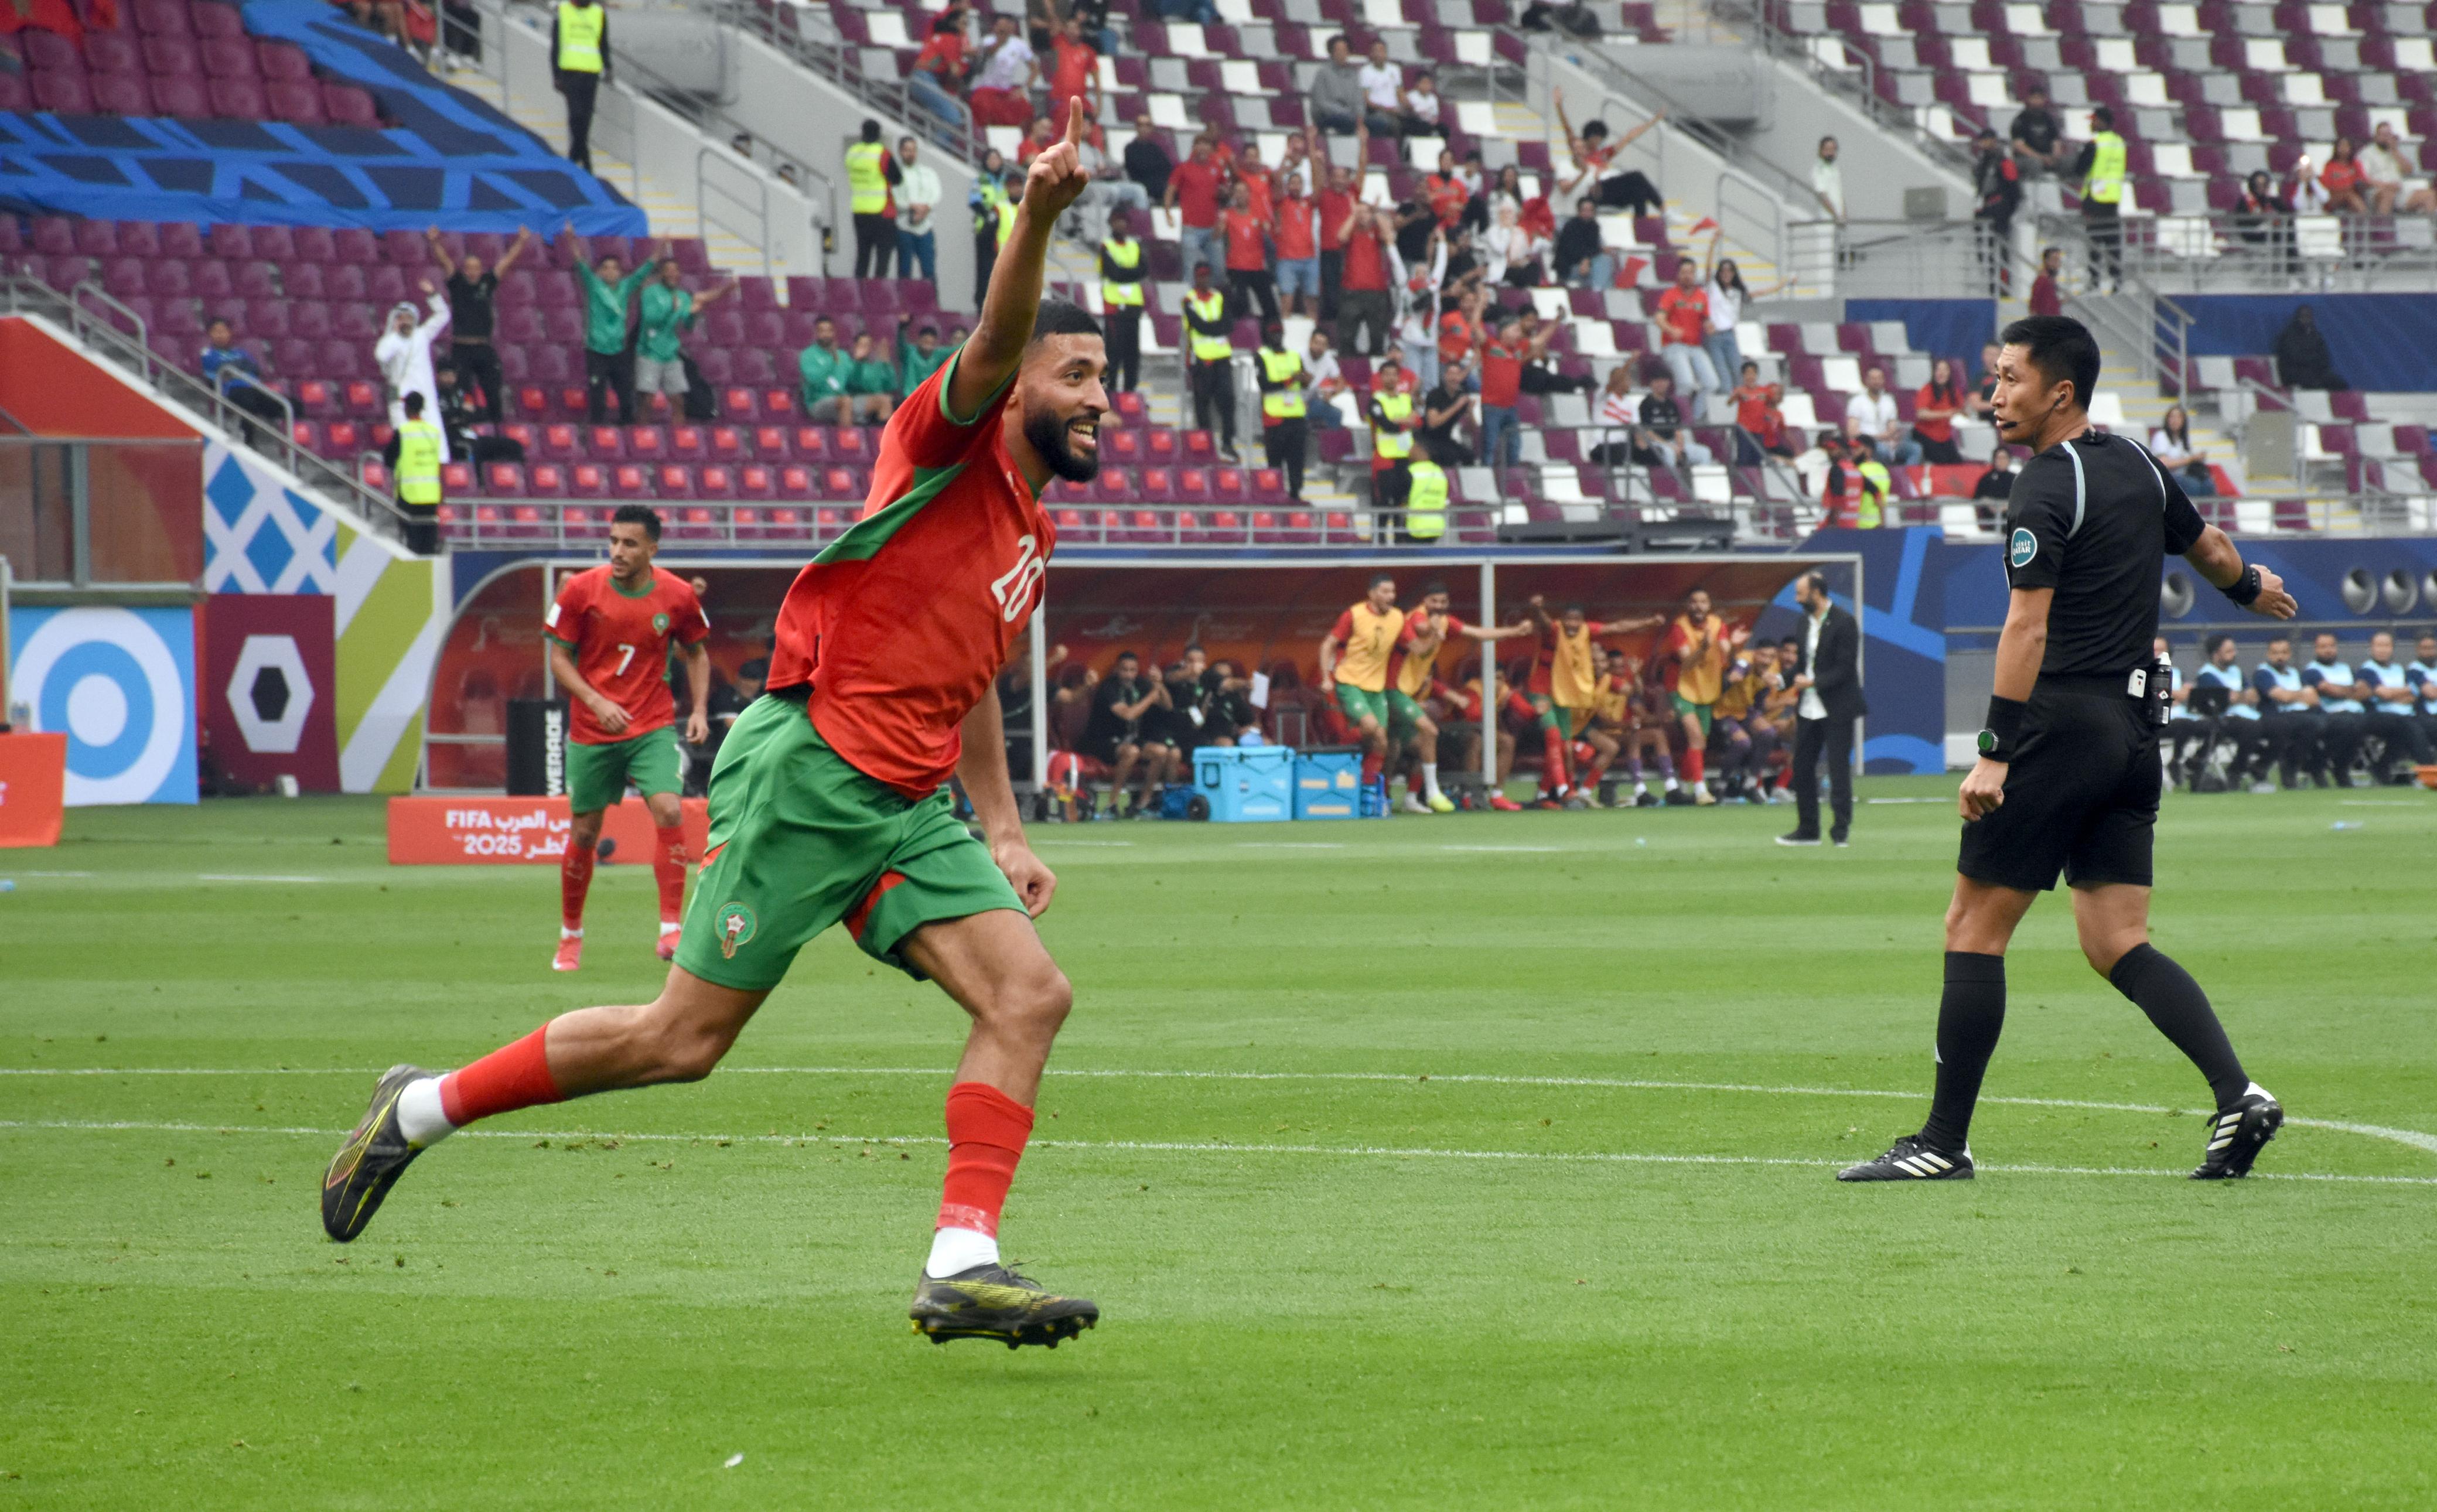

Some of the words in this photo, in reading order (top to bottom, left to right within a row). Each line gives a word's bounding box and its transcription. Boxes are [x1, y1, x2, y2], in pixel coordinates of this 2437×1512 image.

[2013, 546, 2030, 556] QATAR
[991, 534, 1043, 622] 20
[616, 644, 635, 676] 7
[545, 709, 562, 796] WERADE
[446, 810, 493, 828] FIFA
[495, 809, 547, 832] العرب
[464, 834, 522, 855] 2025
